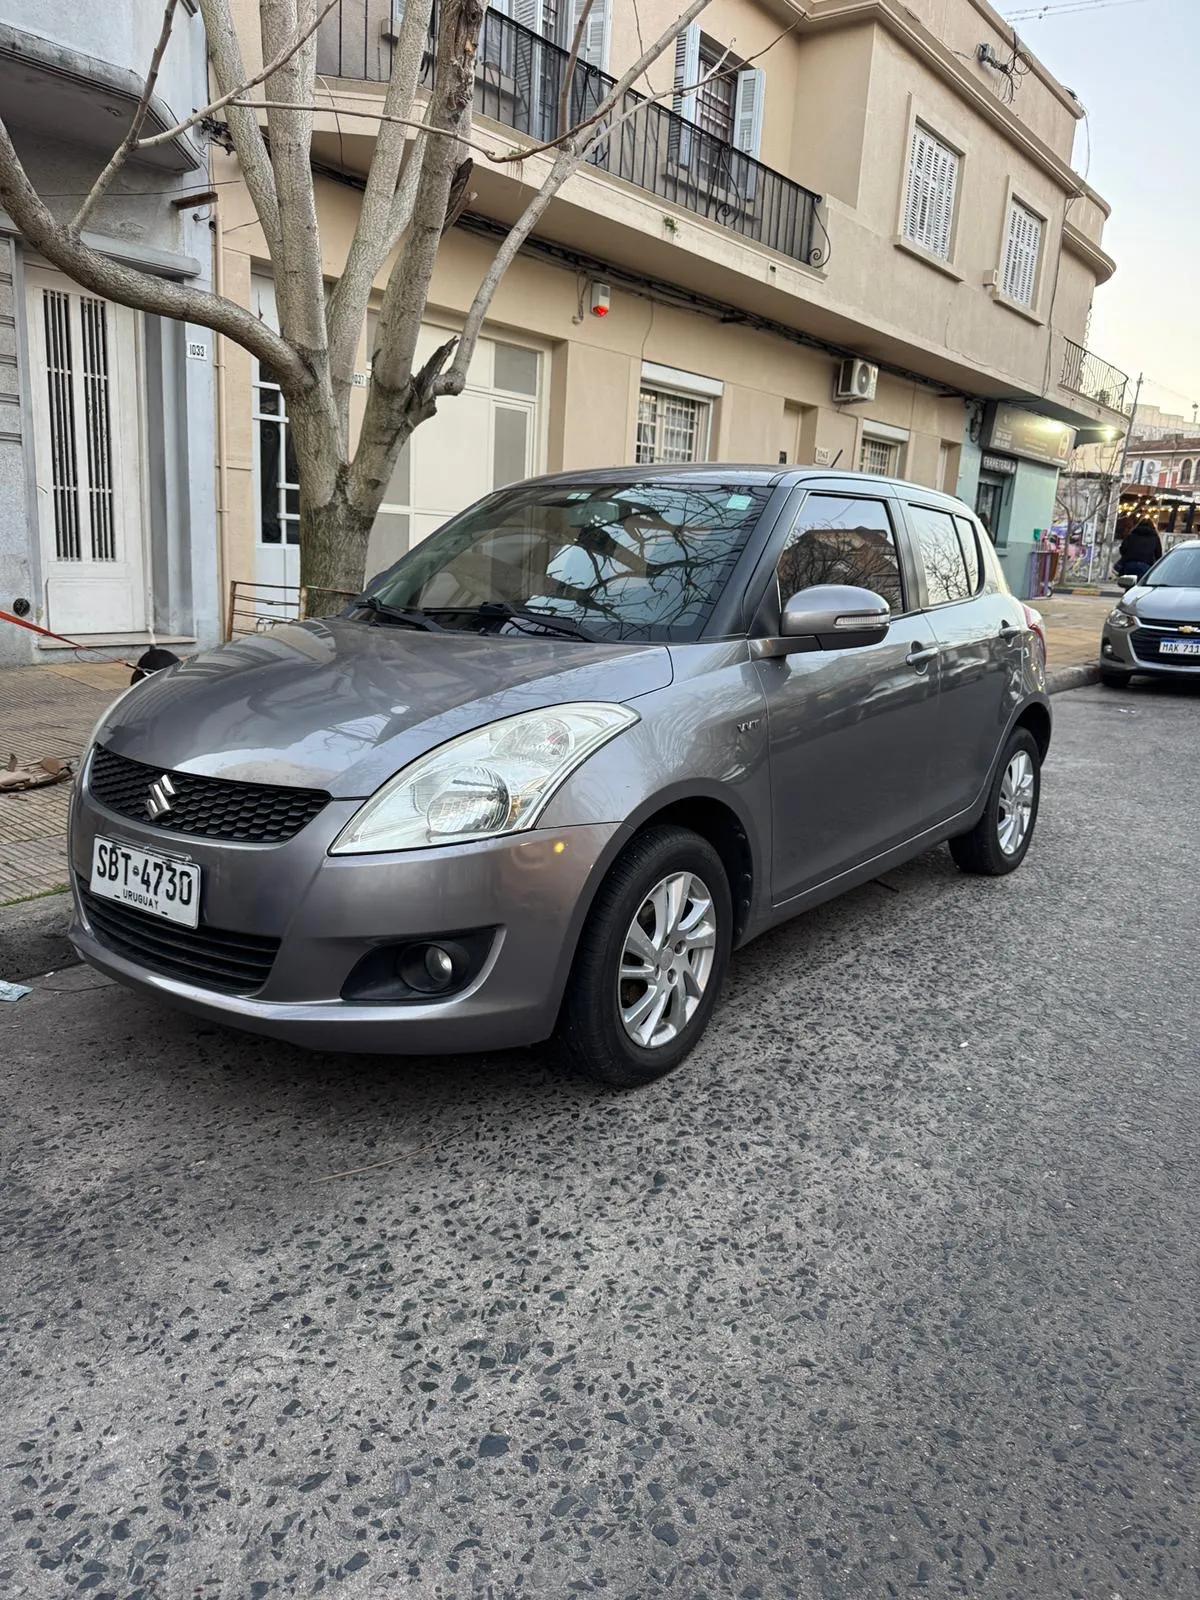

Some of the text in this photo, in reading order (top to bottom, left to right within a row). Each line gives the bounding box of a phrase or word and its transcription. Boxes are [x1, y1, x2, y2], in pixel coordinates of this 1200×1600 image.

[189, 343, 205, 357] 1033
[1162, 643, 1179, 653] MAK
[123, 888, 159, 909] URUGUAY
